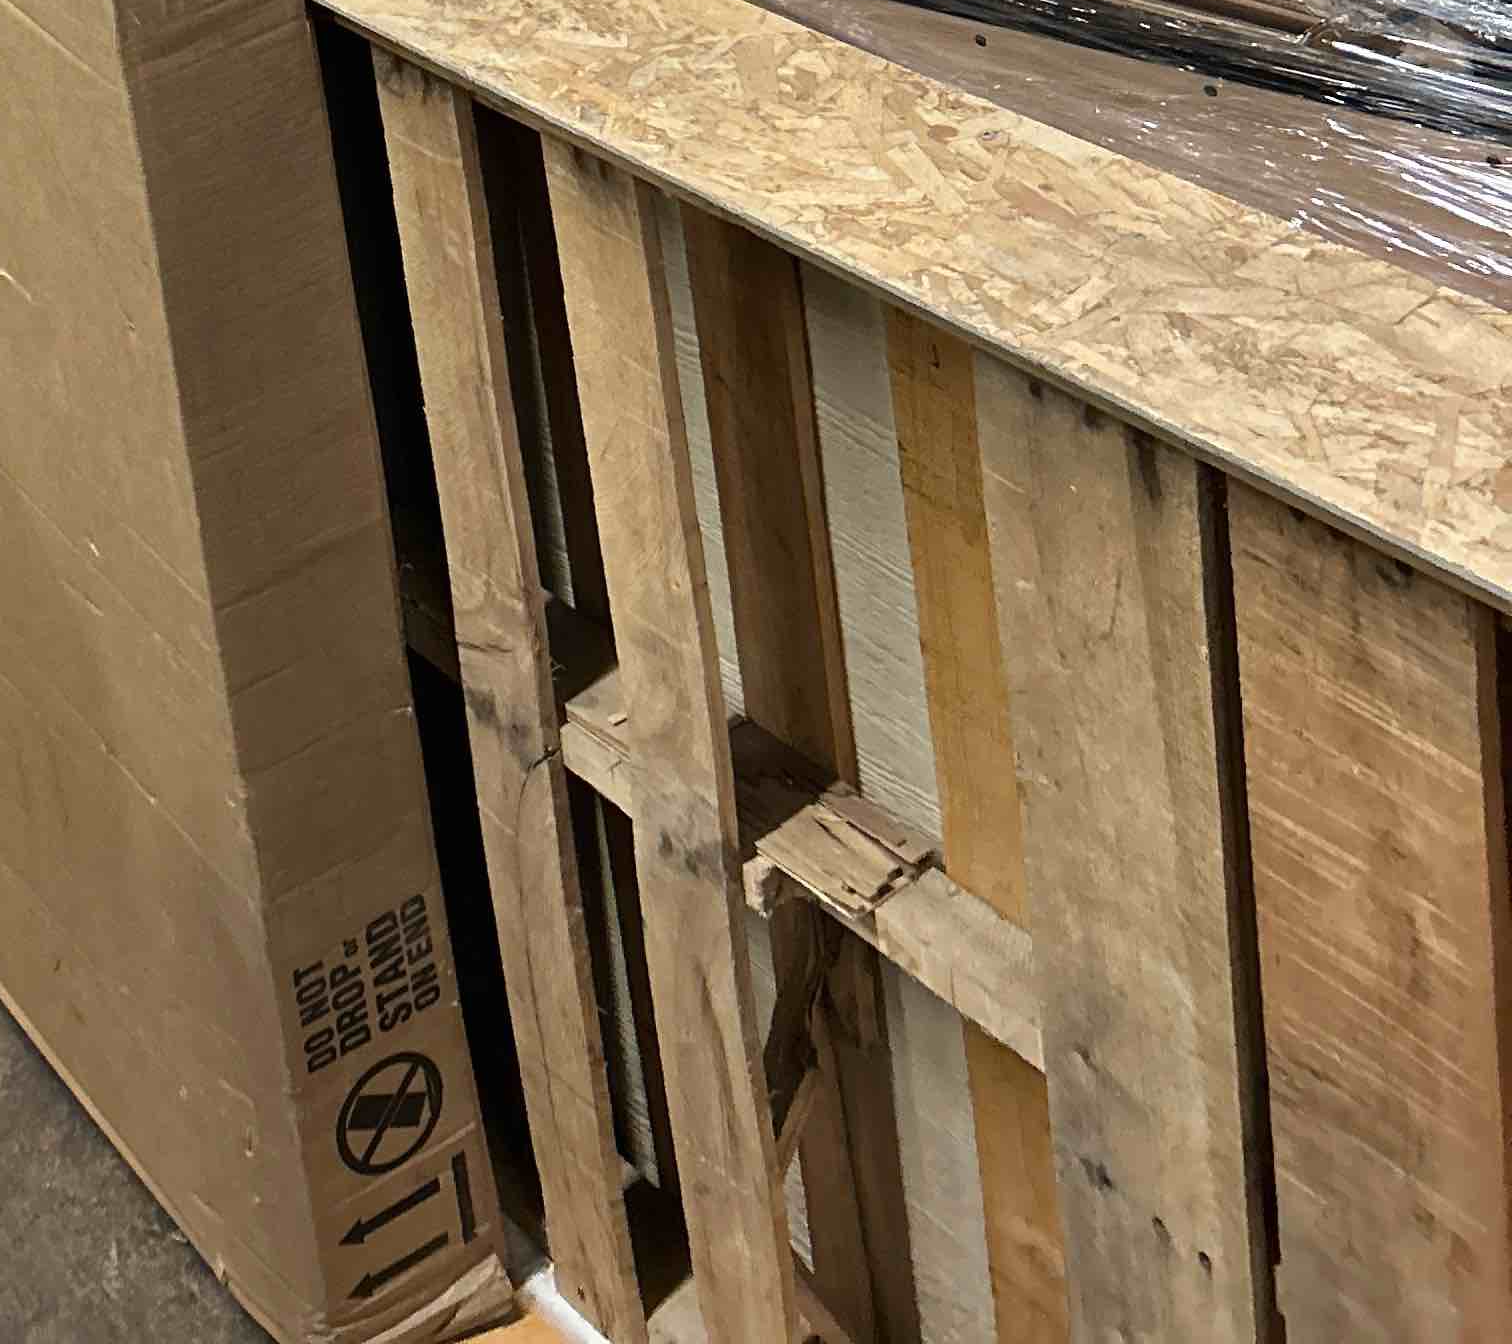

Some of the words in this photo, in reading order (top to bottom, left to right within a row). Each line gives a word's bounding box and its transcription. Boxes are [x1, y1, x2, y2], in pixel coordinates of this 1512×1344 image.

[400, 894, 433, 964] END
[293, 960, 330, 1027] NOT
[365, 911, 413, 1032] STAND
[411, 963, 440, 1011] ON
[329, 965, 371, 1056] DROP
[304, 1027, 337, 1073] DO
